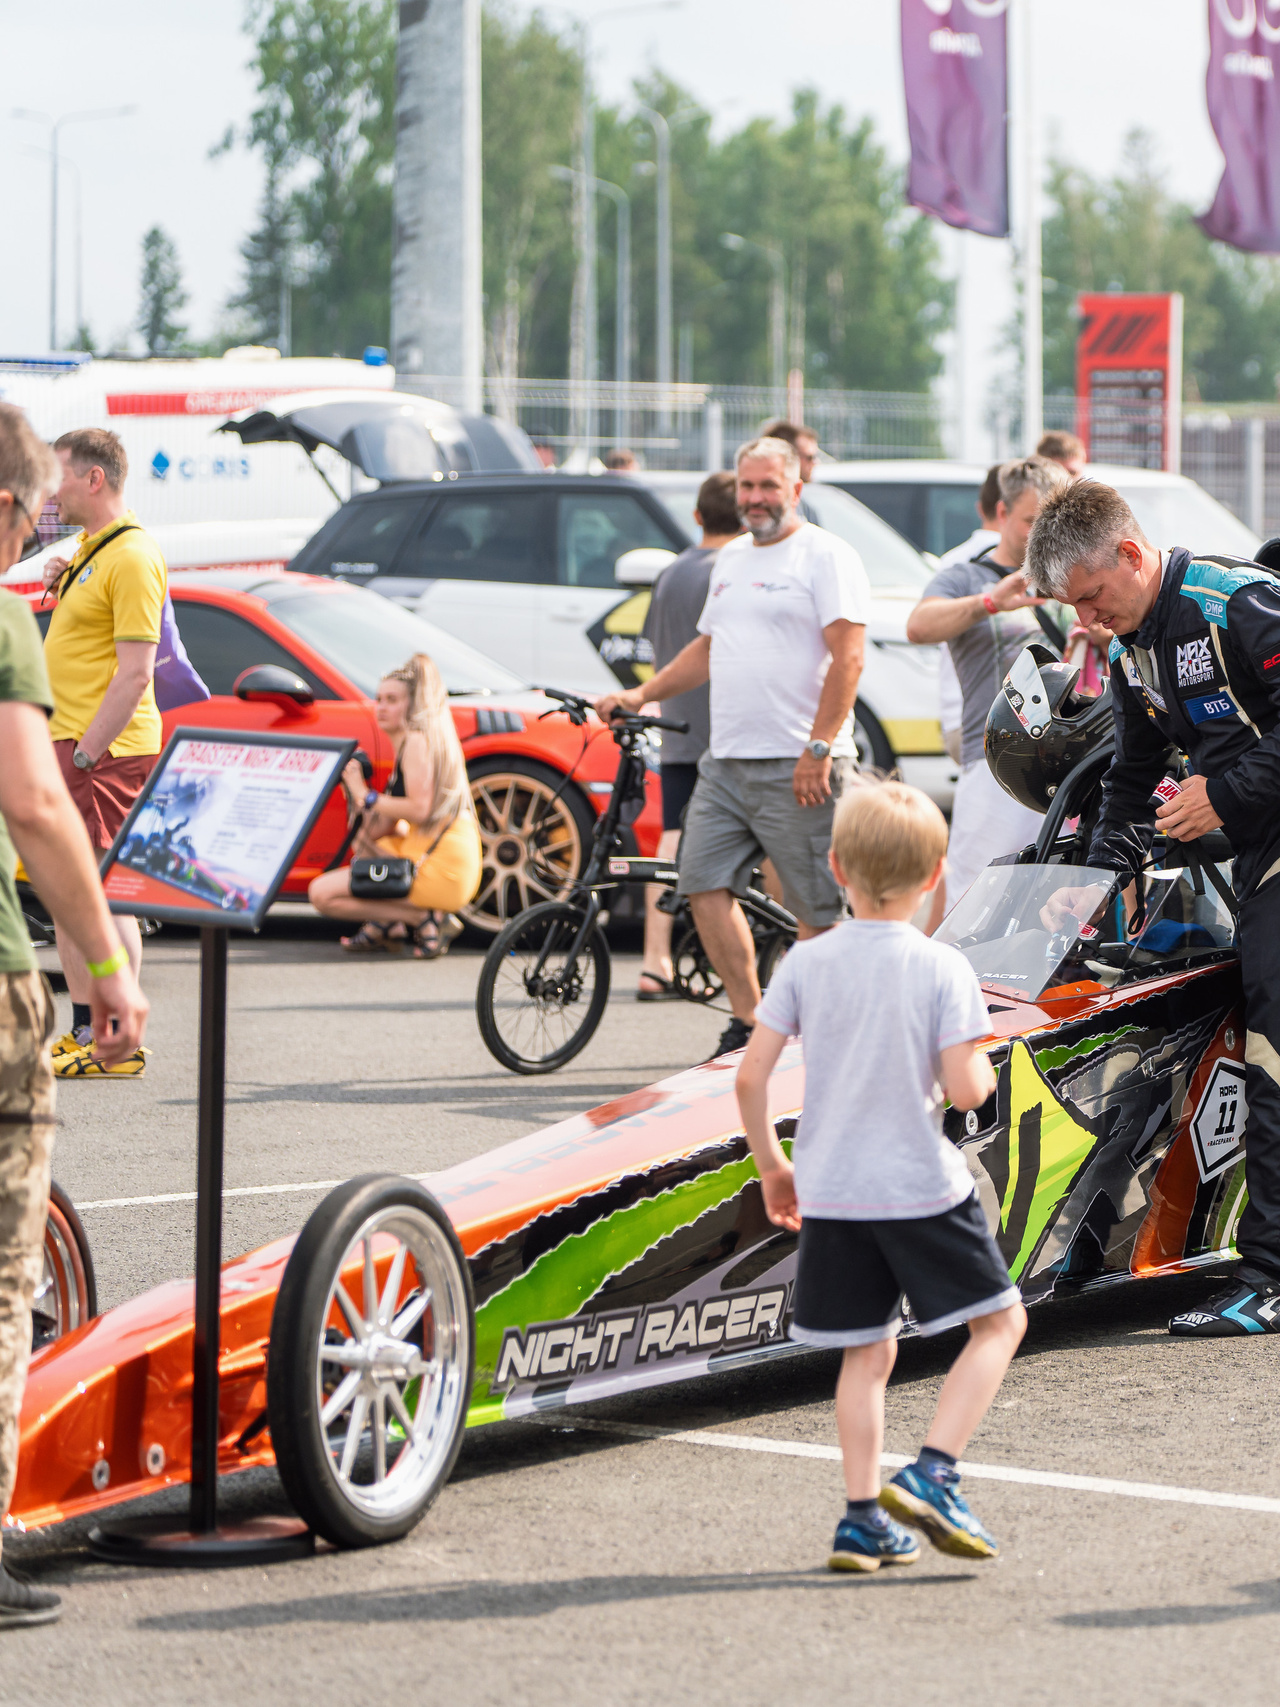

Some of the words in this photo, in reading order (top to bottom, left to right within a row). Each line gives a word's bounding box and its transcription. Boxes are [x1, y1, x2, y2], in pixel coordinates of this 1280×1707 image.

[1205, 601, 1224, 616] OMP
[1176, 636, 1211, 662] MAX
[1178, 671, 1215, 688] MOTORSPORT
[1203, 698, 1231, 714] ВТБ
[1214, 1100, 1238, 1137] 11
[1209, 1137, 1233, 1147] RACEPARK
[497, 1317, 635, 1383] NIGHT
[639, 1289, 786, 1358] RACER
